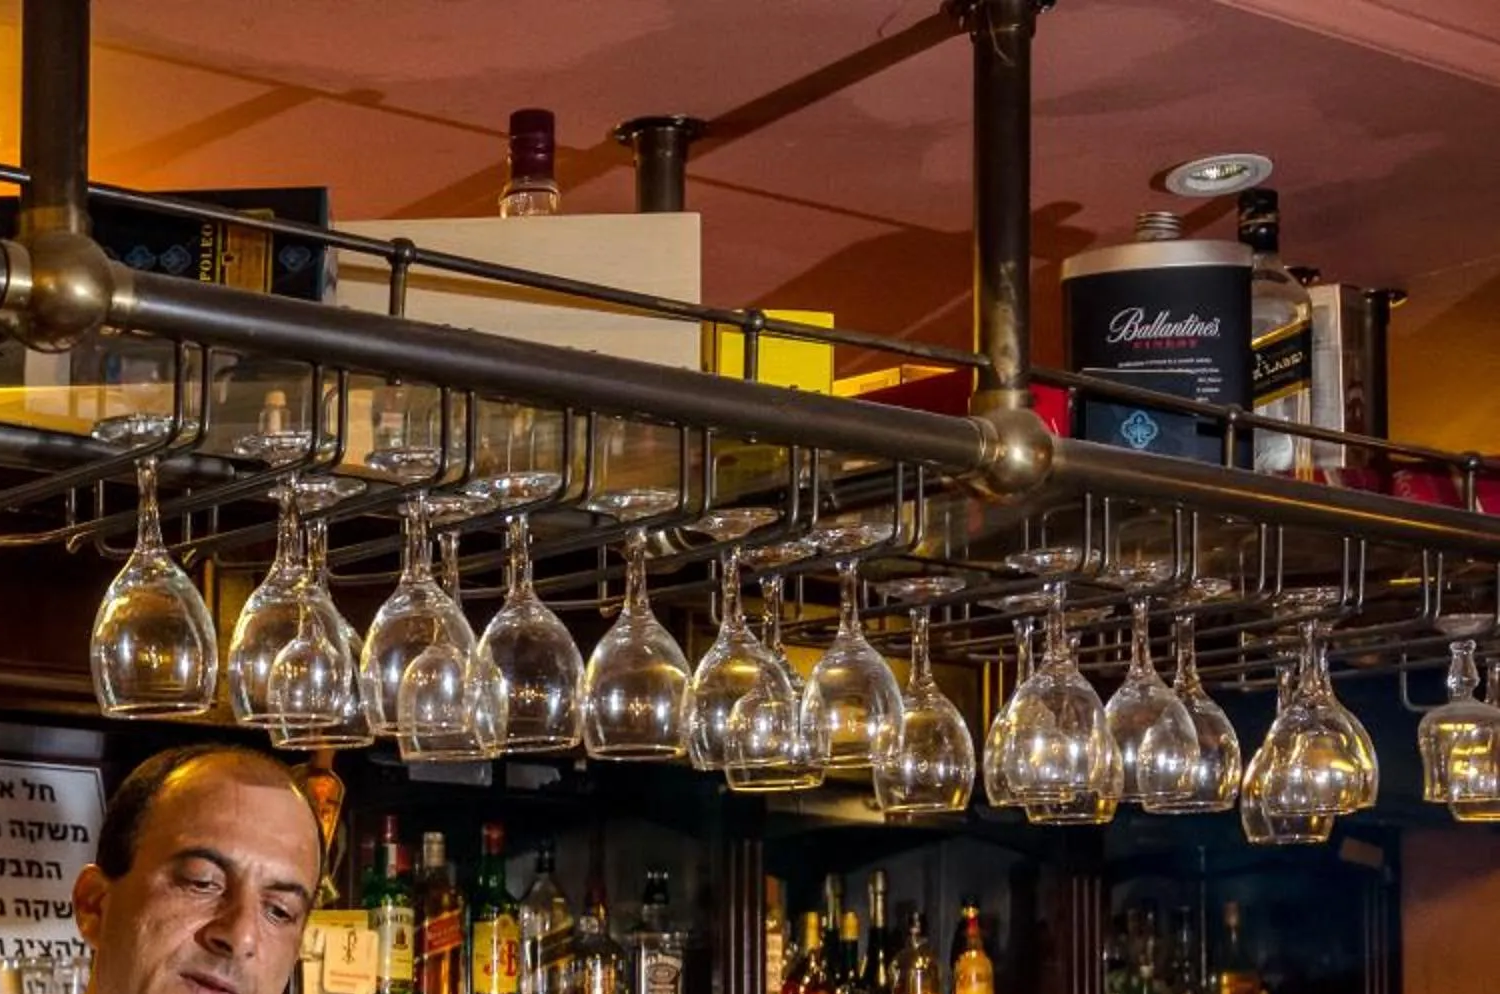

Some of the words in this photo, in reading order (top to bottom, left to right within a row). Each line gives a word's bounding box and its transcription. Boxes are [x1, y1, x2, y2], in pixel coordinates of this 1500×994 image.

[21, 778, 57, 803] חל
[9, 819, 90, 844] משקה
[14, 898, 73, 922] שקה
[14, 936, 85, 961] להציג
